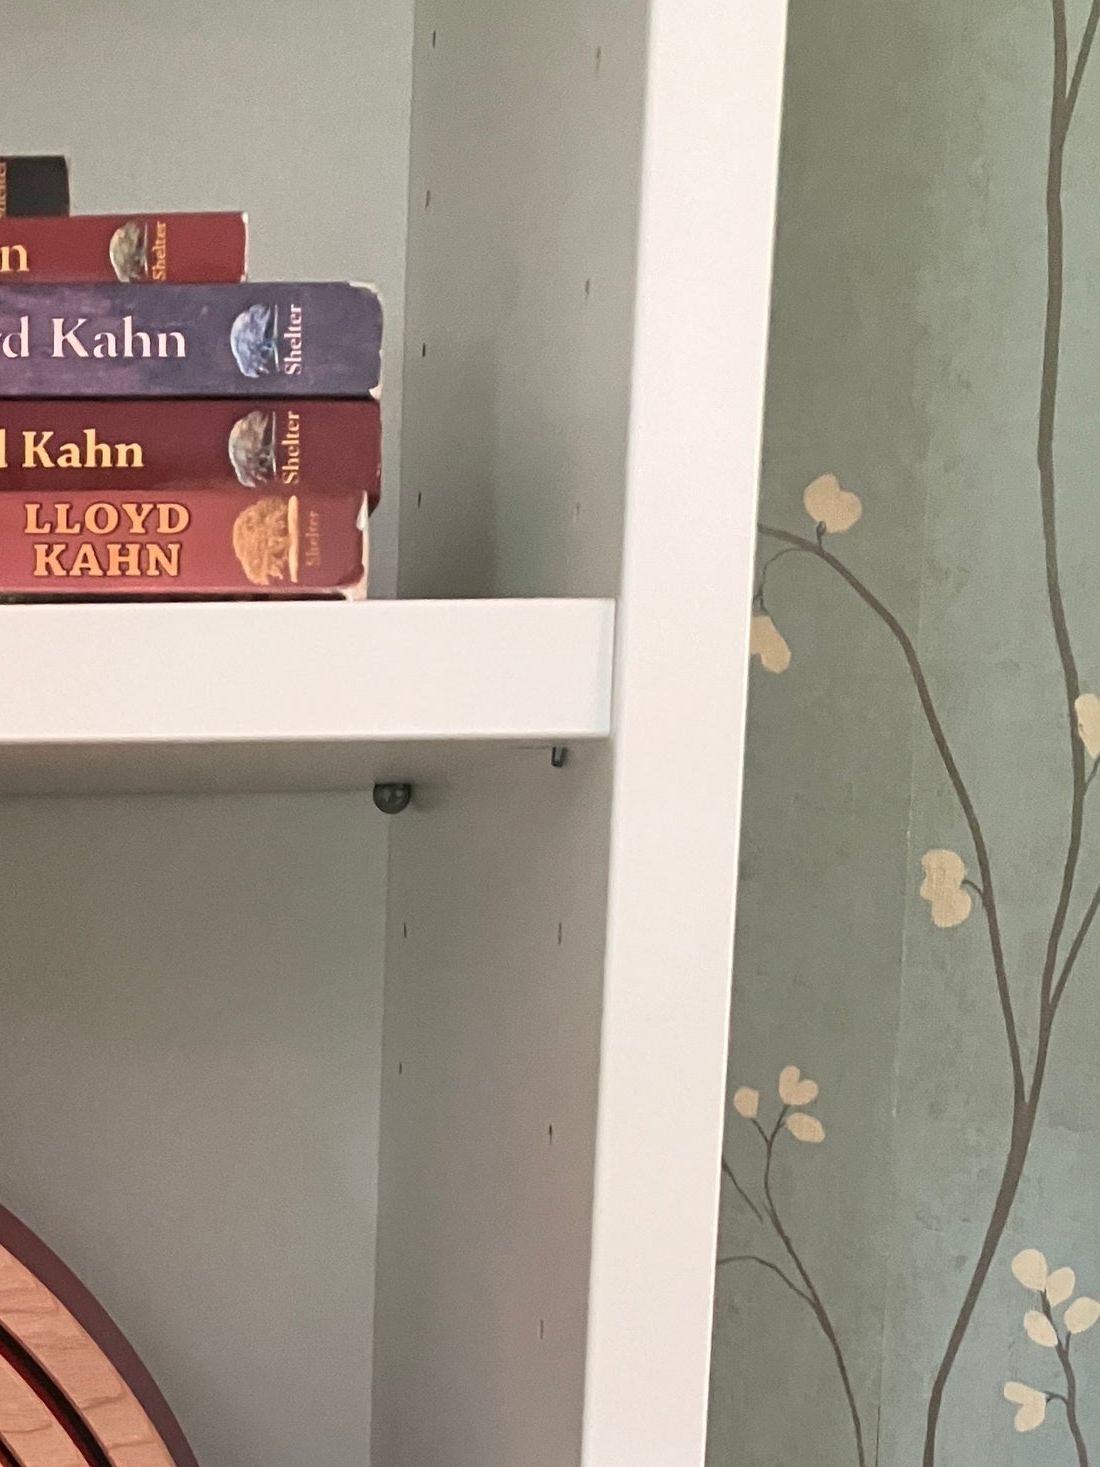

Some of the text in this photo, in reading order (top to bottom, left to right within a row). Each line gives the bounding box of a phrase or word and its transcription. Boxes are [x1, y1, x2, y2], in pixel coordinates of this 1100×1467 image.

[152, 220, 167, 281] Shelter
[51, 316, 187, 359] Kahn
[283, 303, 303, 376] Shelter
[21, 428, 145, 469] Kahn
[282, 410, 301, 485] Shelter
[24, 502, 191, 536] LLOYD
[304, 510, 322, 569] Shelter
[33, 542, 183, 578] KAHN
